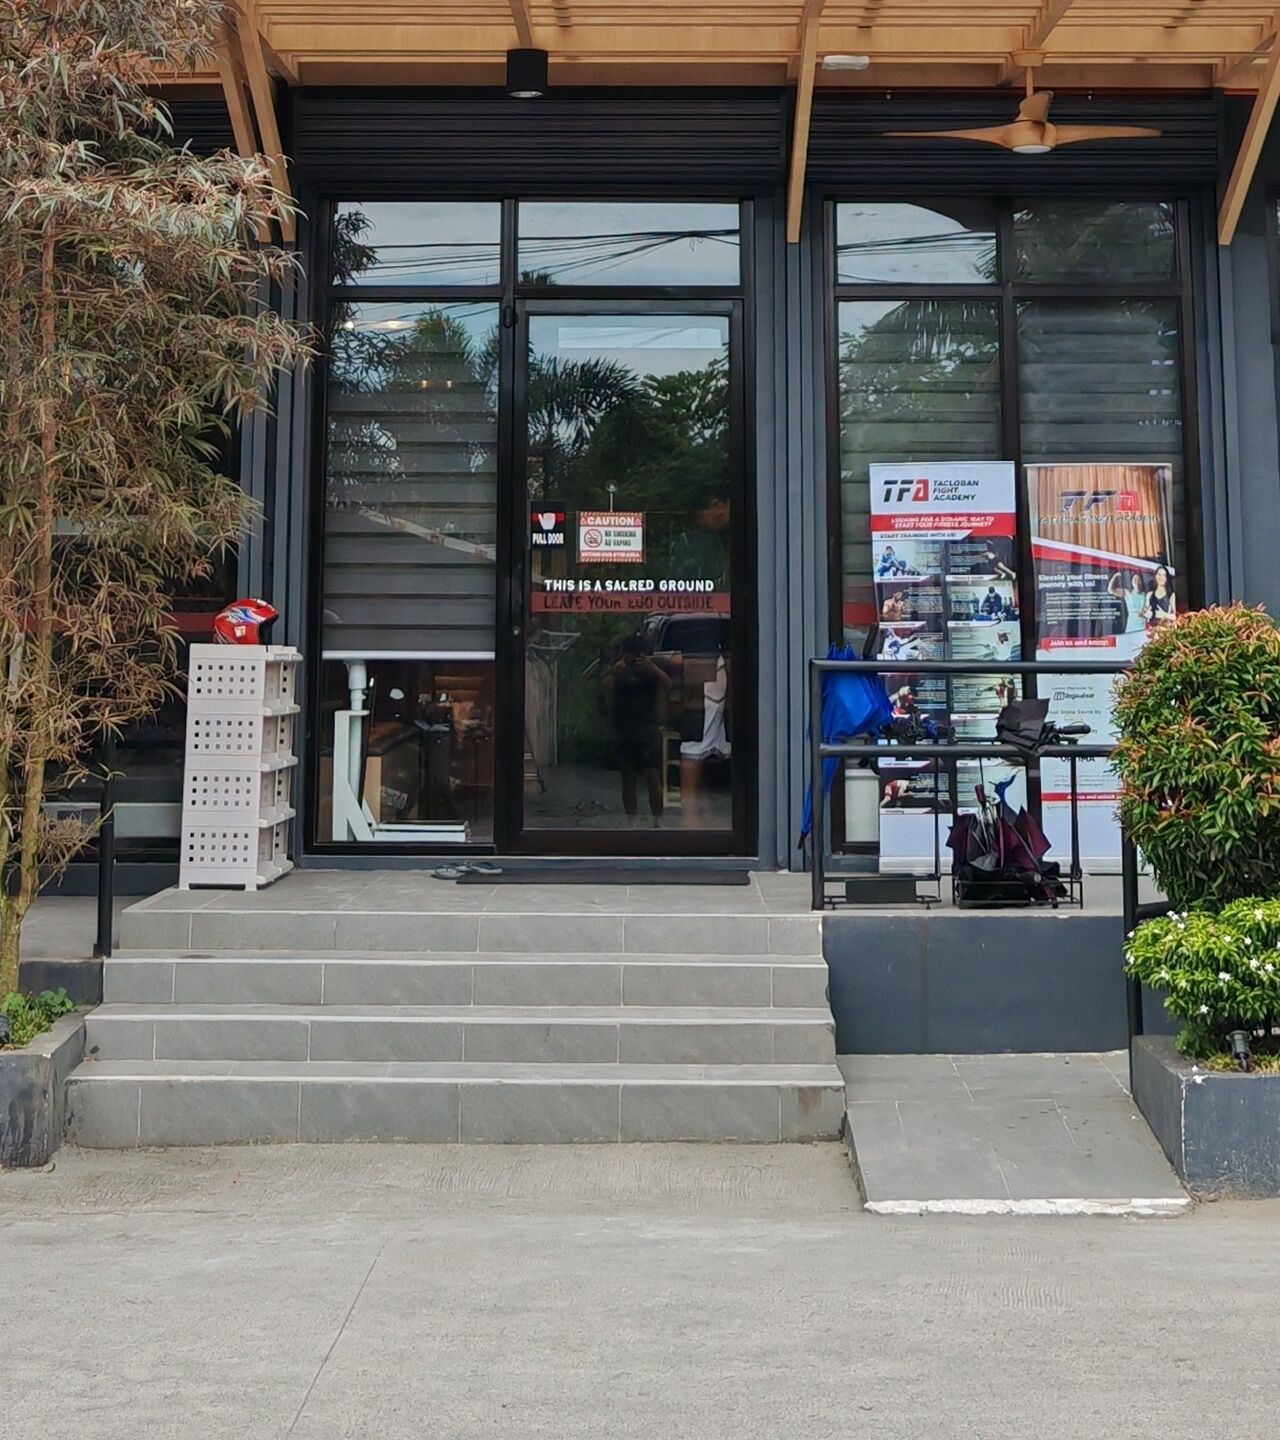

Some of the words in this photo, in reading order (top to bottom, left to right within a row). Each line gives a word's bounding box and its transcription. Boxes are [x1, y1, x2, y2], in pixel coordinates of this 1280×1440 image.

[883, 478, 929, 502] TFA
[587, 516, 635, 526] CAUTION
[532, 533, 547, 544] PULL
[548, 533, 564, 545] DOOR
[544, 579, 575, 591] THIS
[579, 579, 592, 591] IS
[594, 579, 602, 591] A
[606, 579, 655, 591] SACRED
[659, 579, 715, 591] GROUND
[544, 595, 581, 609] LEAVE
[588, 596, 621, 609] YOUR
[628, 596, 653, 609] EGO
[657, 595, 713, 609] OUTSIDE
